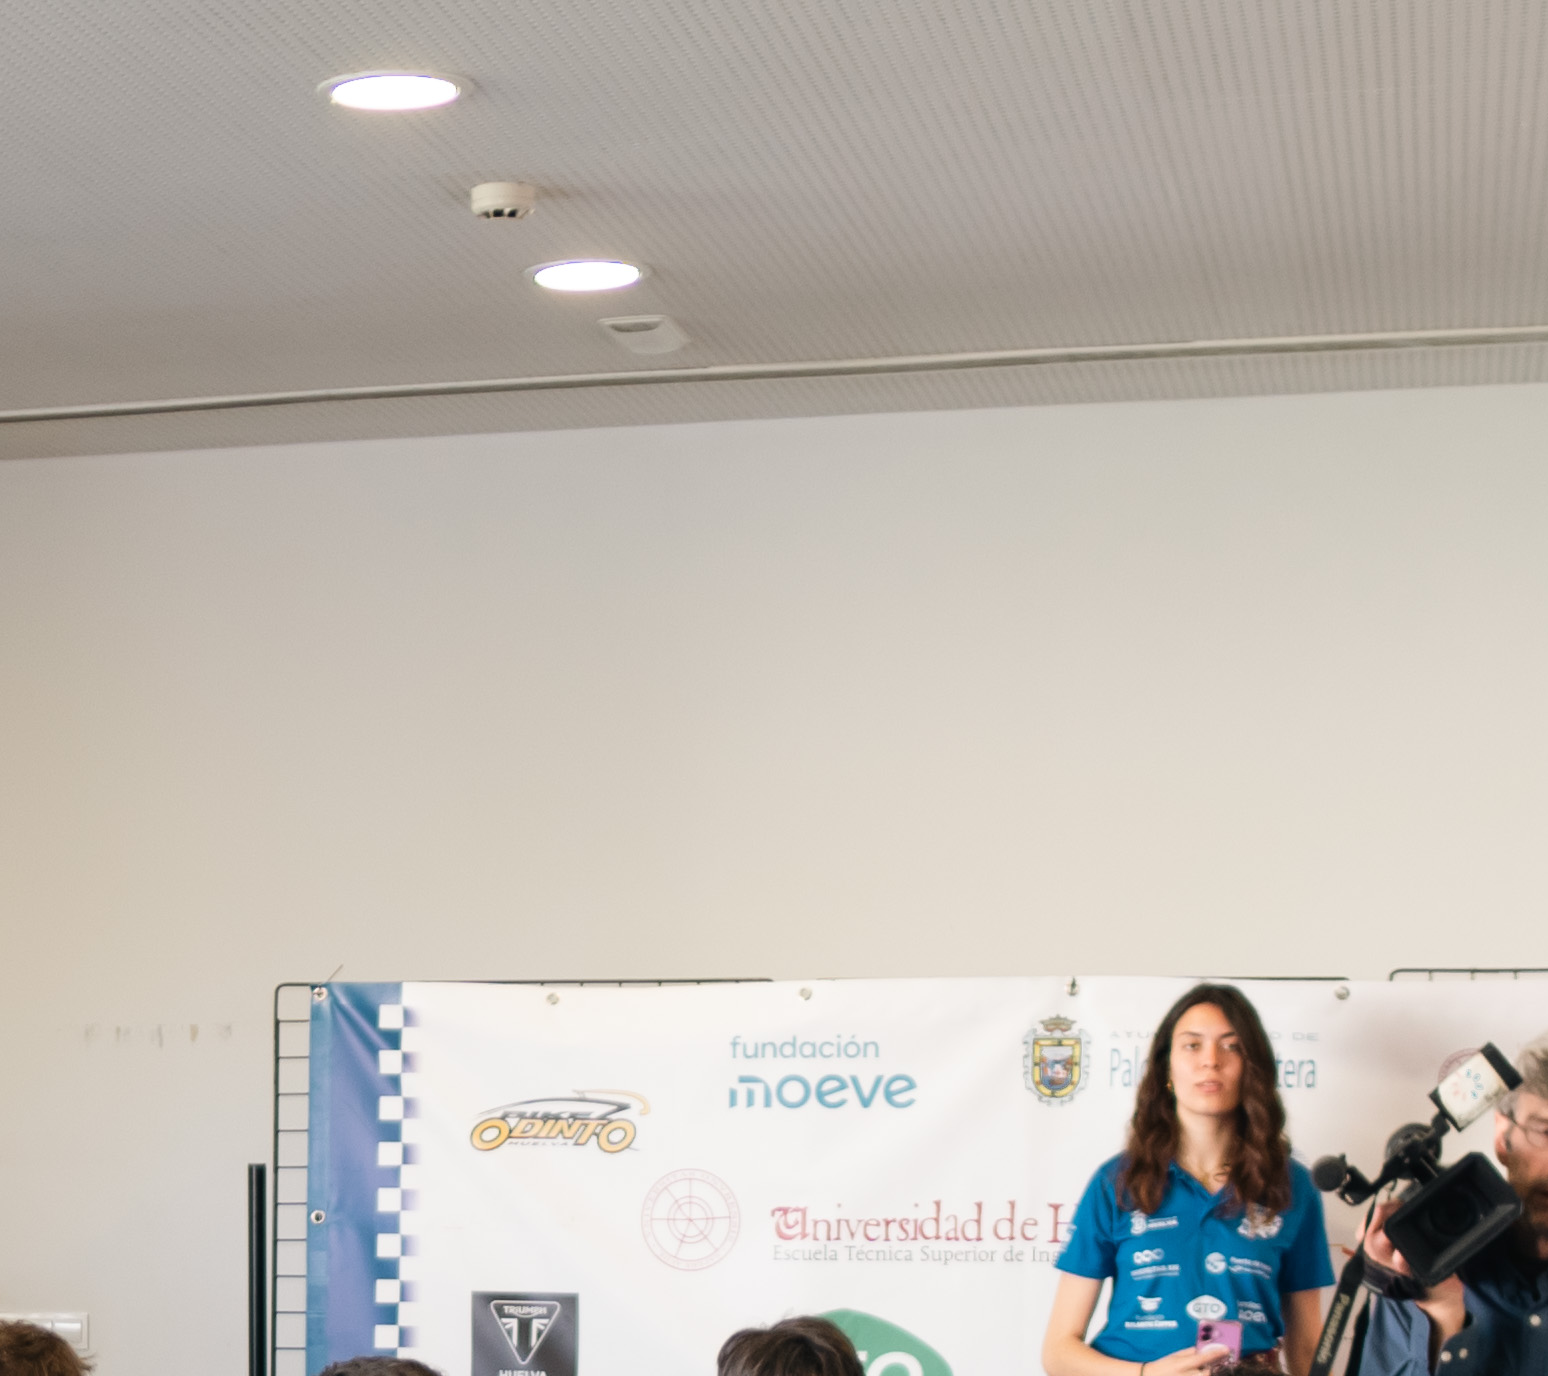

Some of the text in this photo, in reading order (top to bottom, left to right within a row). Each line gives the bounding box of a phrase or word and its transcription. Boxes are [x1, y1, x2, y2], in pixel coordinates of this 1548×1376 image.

[730, 1034, 880, 1060] fundación
[727, 1073, 918, 1110] moeve
[771, 1200, 984, 1242] Universidad
[993, 1200, 1039, 1242] de
[773, 1245, 838, 1262] Escuela
[845, 1244, 913, 1262] Técnica
[920, 1245, 996, 1265] Superior
[1003, 1245, 1024, 1262] de
[503, 1305, 547, 1315] TRIUMPH
